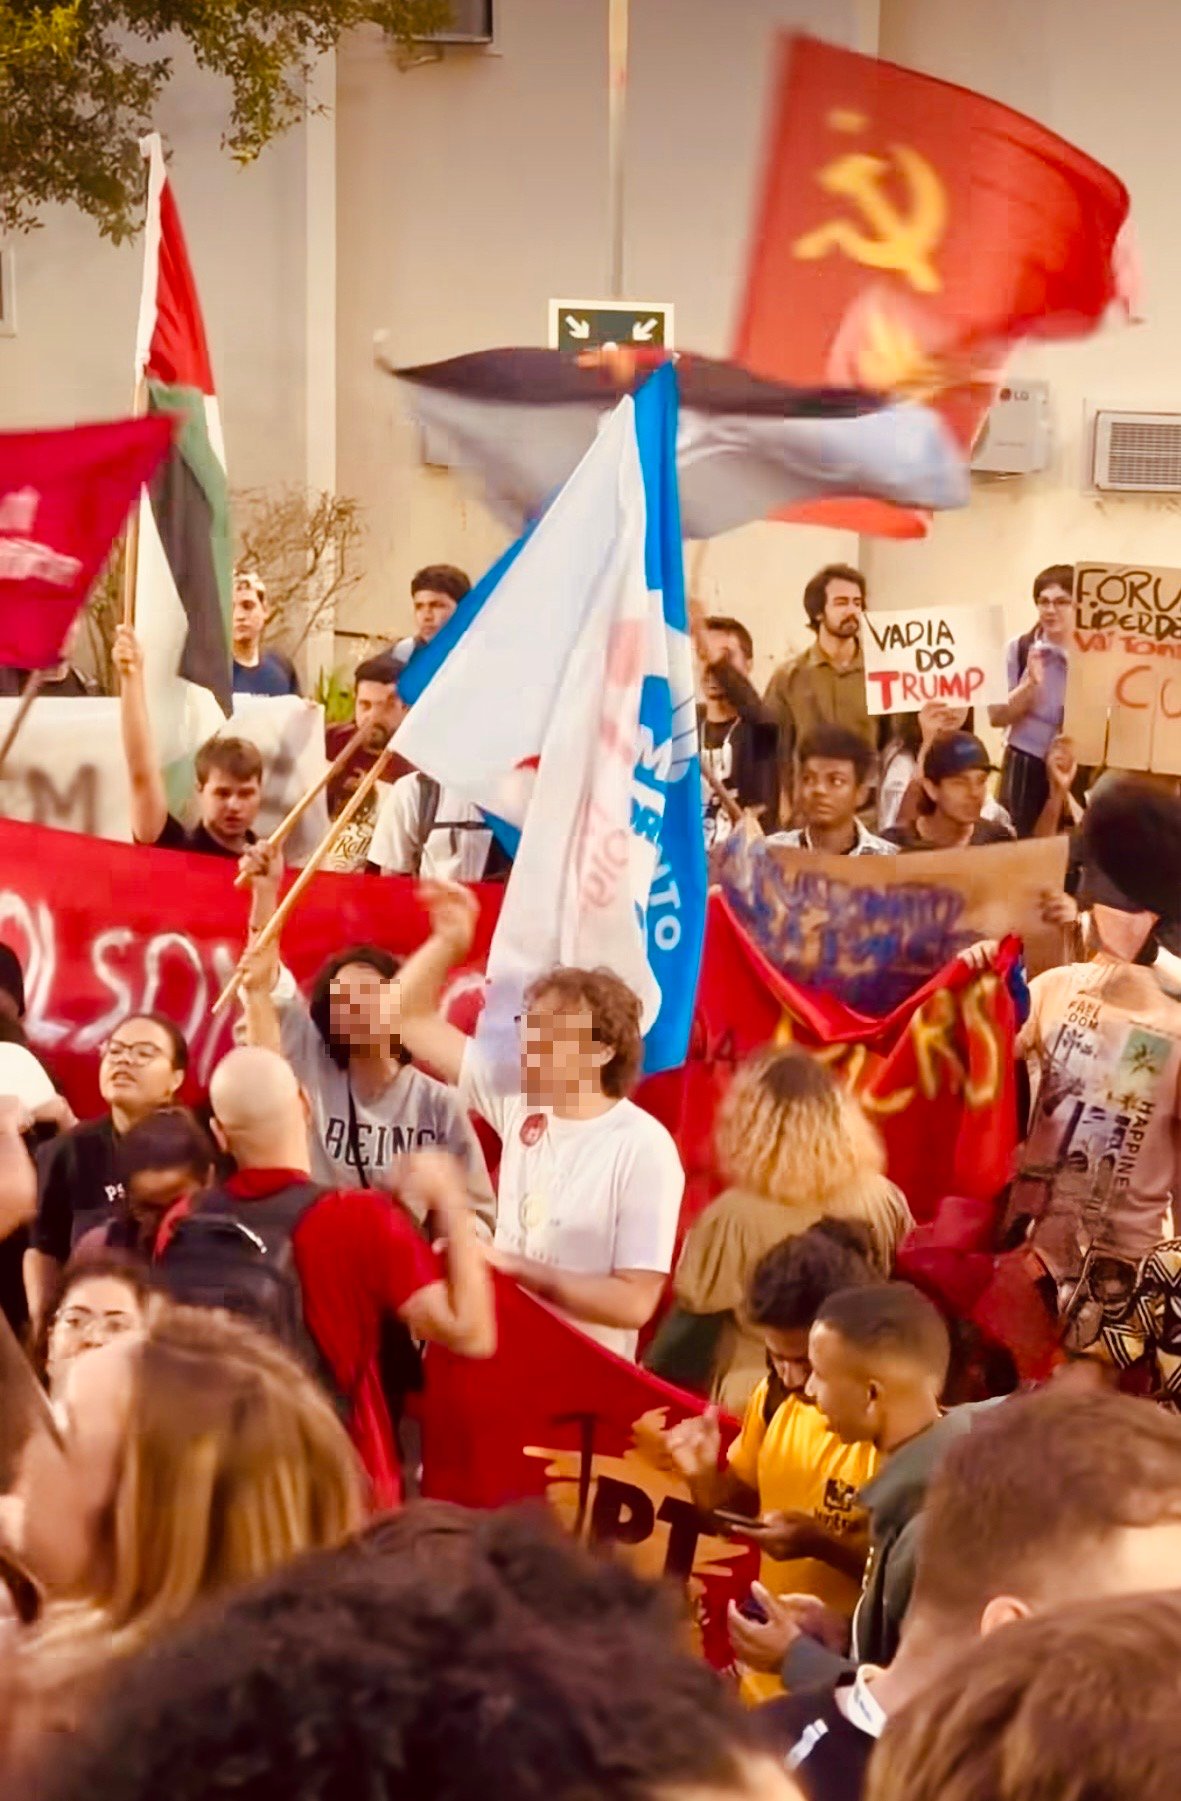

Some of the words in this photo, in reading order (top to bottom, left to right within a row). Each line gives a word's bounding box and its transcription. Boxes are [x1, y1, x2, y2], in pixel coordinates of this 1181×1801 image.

[1013, 390, 1030, 401] LG
[1076, 568, 1181, 612] FORU
[864, 612, 955, 651] VADIA
[915, 648, 954, 673] DO
[868, 666, 984, 711] TRUMP
